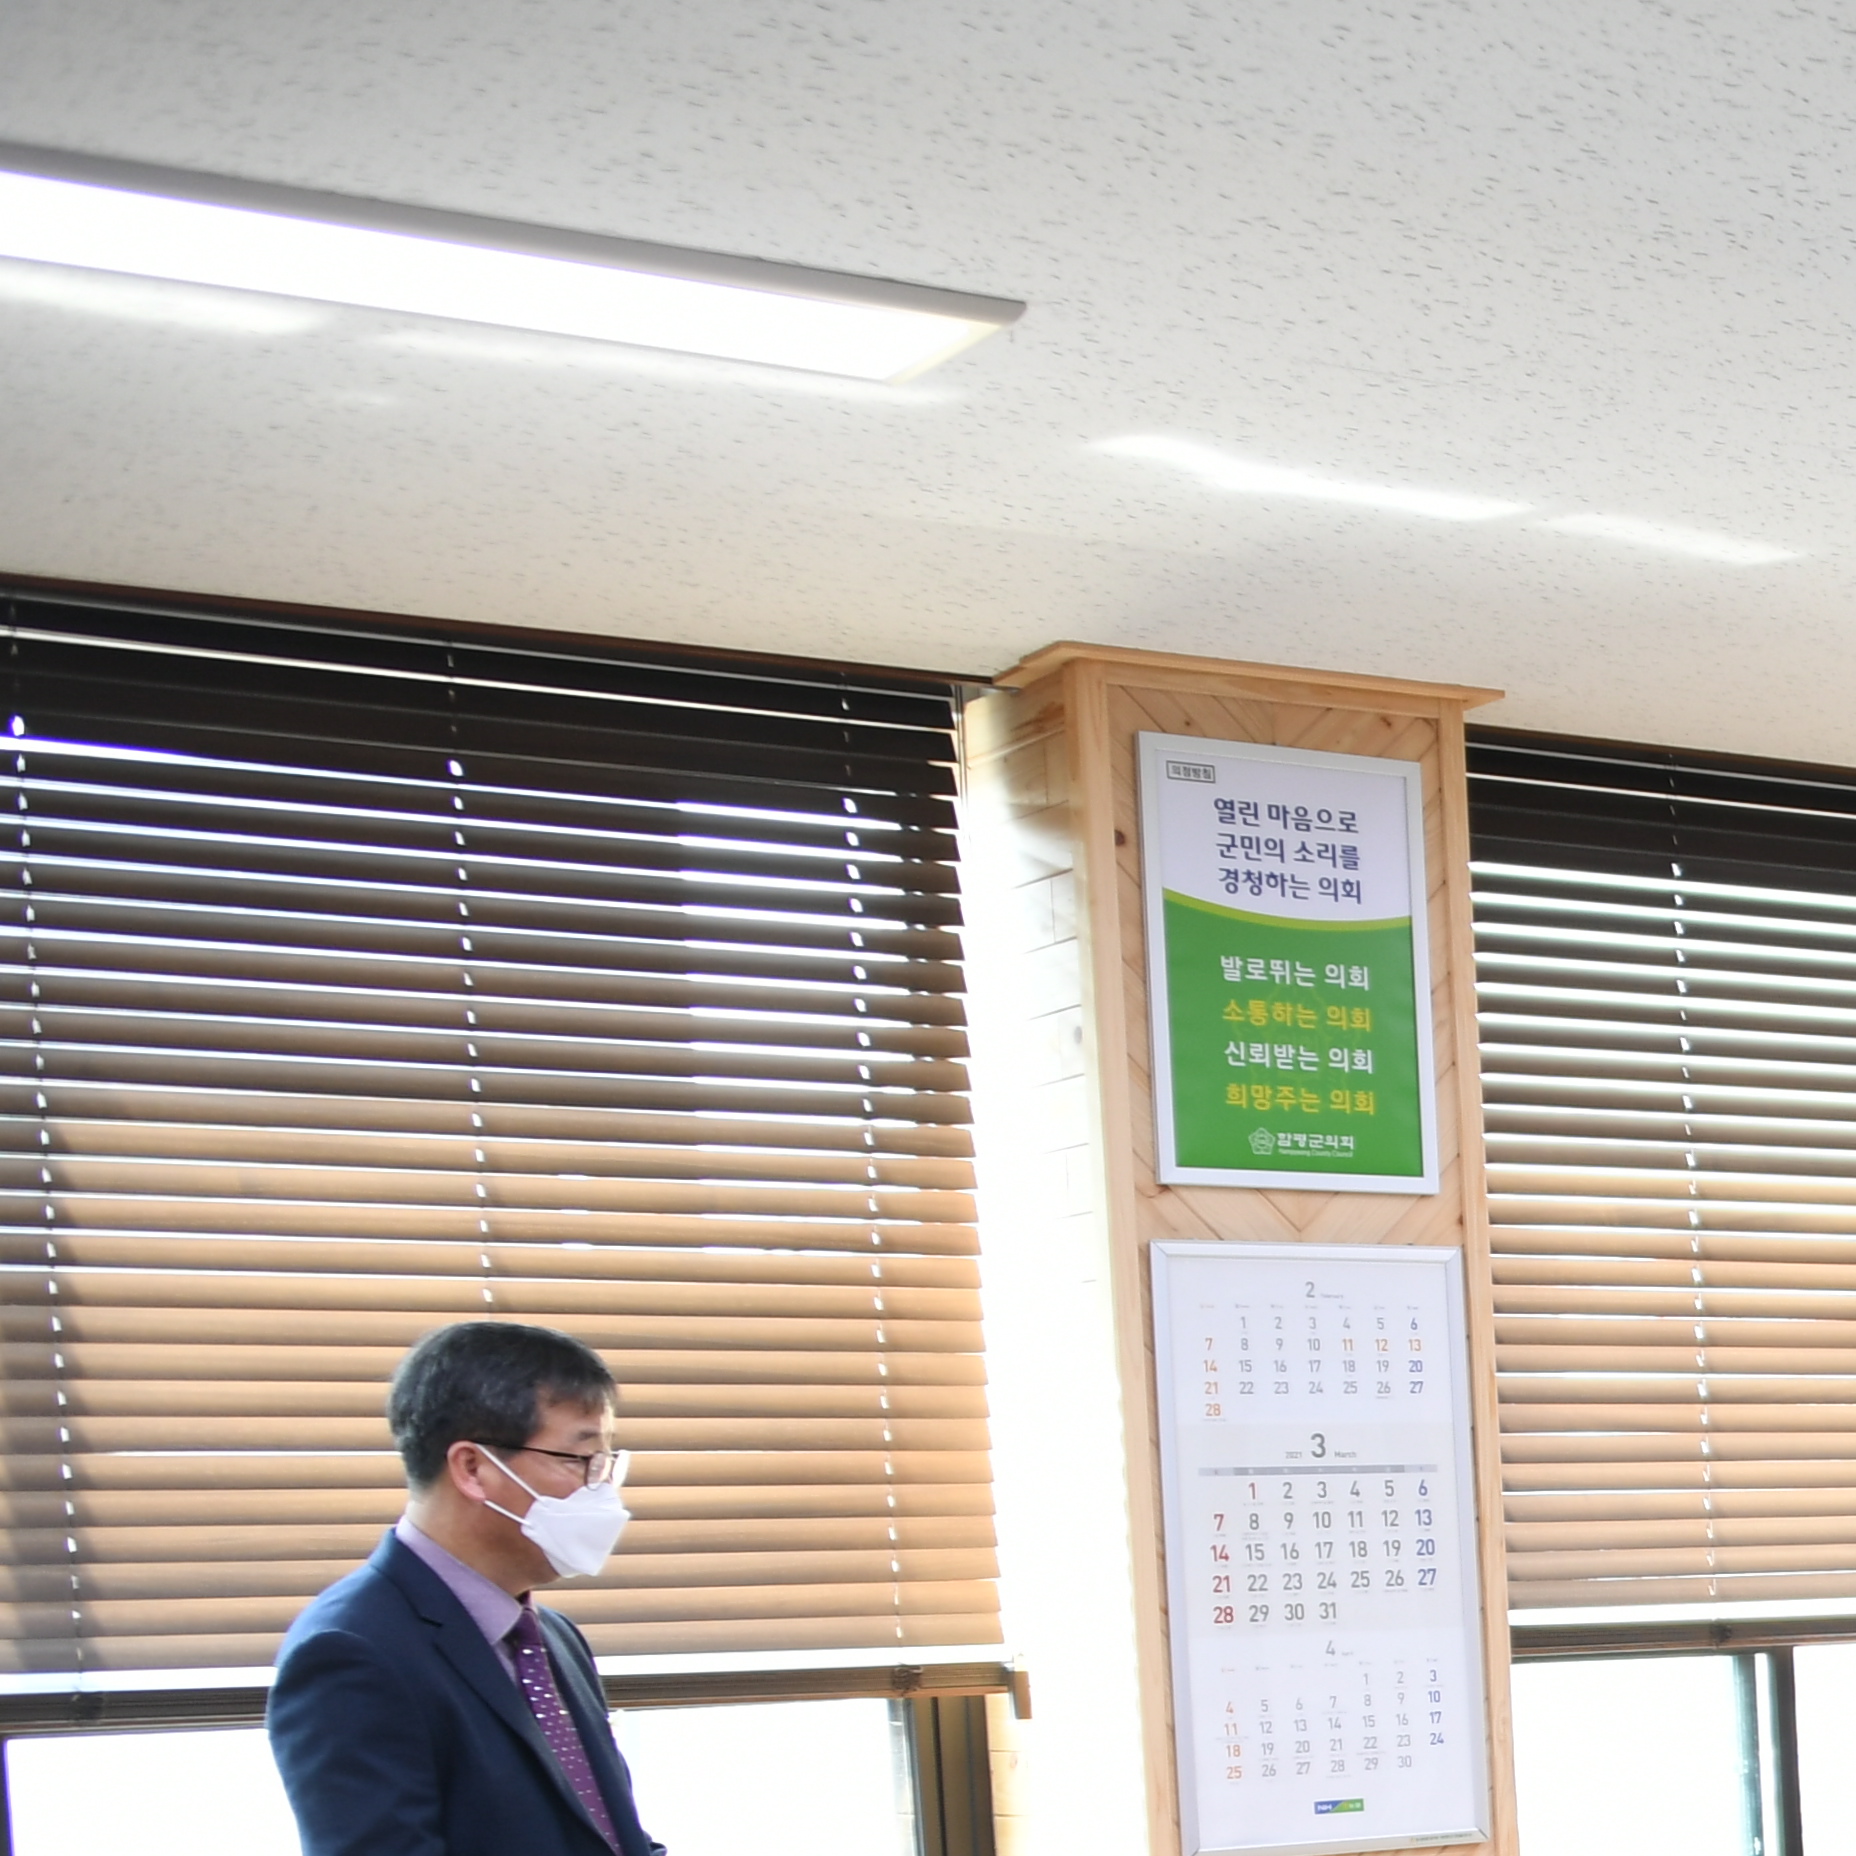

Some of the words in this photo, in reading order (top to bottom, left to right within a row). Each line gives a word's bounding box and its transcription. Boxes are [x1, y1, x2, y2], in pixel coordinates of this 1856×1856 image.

[1214, 798, 1259, 827] 열린
[1267, 804, 1359, 833] 마음으로
[1216, 833, 1285, 863] 군민의
[1293, 841, 1361, 870] 소리를
[1219, 868, 1310, 900] 경청하는
[1318, 877, 1361, 904] 의회
[1220, 956, 1316, 987] 발로뛰는
[1324, 964, 1369, 990] 의회
[1223, 1000, 1317, 1028] 소통하는
[1326, 1005, 1371, 1031] 의회
[1224, 1041, 1319, 1071] 신뢰받는
[1328, 1047, 1373, 1073] 의회
[1226, 1084, 1320, 1112] 희망주는
[1330, 1089, 1376, 1114] 의회
[1277, 1132, 1354, 1150] 함평군의회
[1306, 1282, 1315, 1298] 2
[1241, 1316, 1246, 1328] 1
[1275, 1316, 1282, 1329] 2
[1309, 1317, 1316, 1329] 3
[1343, 1317, 1350, 1329] 4
[1377, 1318, 1384, 1330] 5
[1411, 1318, 1417, 1330] 6
[1205, 1338, 1213, 1350] 7
[1241, 1338, 1248, 1351] 8
[1276, 1338, 1283, 1350] 9
[1308, 1338, 1320, 1351] 10
[1342, 1339, 1353, 1351] 11
[1375, 1339, 1388, 1351] 12
[1409, 1339, 1421, 1351] 13
[1204, 1360, 1217, 1372] 14
[1239, 1360, 1252, 1372] 15
[1274, 1360, 1287, 1372] 16
[1309, 1360, 1321, 1372] 17
[1343, 1360, 1355, 1372] 18
[1377, 1360, 1389, 1372] 19
[1409, 1360, 1423, 1372] 20
[1205, 1382, 1218, 1394] 21
[1239, 1382, 1254, 1394] 22
[1274, 1381, 1289, 1394] 23
[1309, 1381, 1323, 1394] 24
[1343, 1381, 1357, 1394] 25
[1377, 1381, 1391, 1394] 26
[1410, 1381, 1423, 1393] 27
[1206, 1403, 1221, 1416] 28
[1311, 1433, 1326, 1458] 3
[1334, 1450, 1357, 1459] March
[1249, 1483, 1255, 1499] 1
[1283, 1482, 1293, 1499] 2
[1317, 1481, 1327, 1498] 3
[1350, 1481, 1360, 1497] 4
[1385, 1480, 1394, 1497] 5
[1419, 1480, 1427, 1496] 6
[1214, 1514, 1224, 1531] 7
[1250, 1513, 1259, 1530] 8
[1284, 1512, 1293, 1529] 9
[1313, 1511, 1331, 1528] 10
[1348, 1511, 1363, 1527] 11
[1382, 1510, 1399, 1527] 12
[1415, 1509, 1432, 1526] 13
[1211, 1545, 1229, 1561] 14
[1245, 1543, 1264, 1561] 15
[1281, 1543, 1299, 1560] 16
[1315, 1542, 1333, 1559] 17
[1349, 1541, 1367, 1557] 18
[1383, 1540, 1401, 1556] 19
[1416, 1539, 1435, 1556] 20
[1213, 1575, 1230, 1593] 21
[1247, 1574, 1268, 1591] 22
[1283, 1573, 1302, 1590] 23
[1317, 1572, 1337, 1589] 24
[1351, 1571, 1370, 1588] 25
[1385, 1570, 1404, 1586] 26
[1418, 1568, 1436, 1585] 27
[1214, 1606, 1234, 1623] 28
[1249, 1605, 1269, 1622] 29
[1285, 1603, 1304, 1620] 30
[1319, 1602, 1336, 1619] 31
[1326, 1640, 1335, 1655] 4
[1364, 1673, 1368, 1685] 1
[1397, 1671, 1404, 1684] 2
[1430, 1670, 1437, 1682] 3
[1226, 1701, 1234, 1713] 4
[1261, 1699, 1268, 1712] 5
[1296, 1698, 1303, 1710] 6
[1330, 1696, 1337, 1708] 7
[1364, 1694, 1371, 1706] 8
[1397, 1692, 1404, 1704] 9
[1428, 1690, 1440, 1703] 10
[1225, 1723, 1237, 1736] 11
[1259, 1721, 1272, 1734] 12
[1294, 1719, 1307, 1732] 13
[1328, 1717, 1341, 1729] 14
[1363, 1715, 1375, 1727] 15
[1396, 1713, 1408, 1725] 16
[1430, 1711, 1441, 1723] 17
[1227, 1745, 1241, 1757] 18
[1261, 1743, 1274, 1755] 19
[1295, 1740, 1310, 1753] 20
[1330, 1738, 1342, 1751] 21
[1363, 1736, 1377, 1749] 22
[1397, 1734, 1411, 1747] 23
[1430, 1733, 1444, 1745] 24
[1227, 1766, 1242, 1779] 25
[1262, 1764, 1276, 1777] 26
[1296, 1762, 1310, 1775] 27
[1331, 1760, 1345, 1772] 28
[1364, 1757, 1378, 1770] 29
[1398, 1755, 1412, 1768] 30
